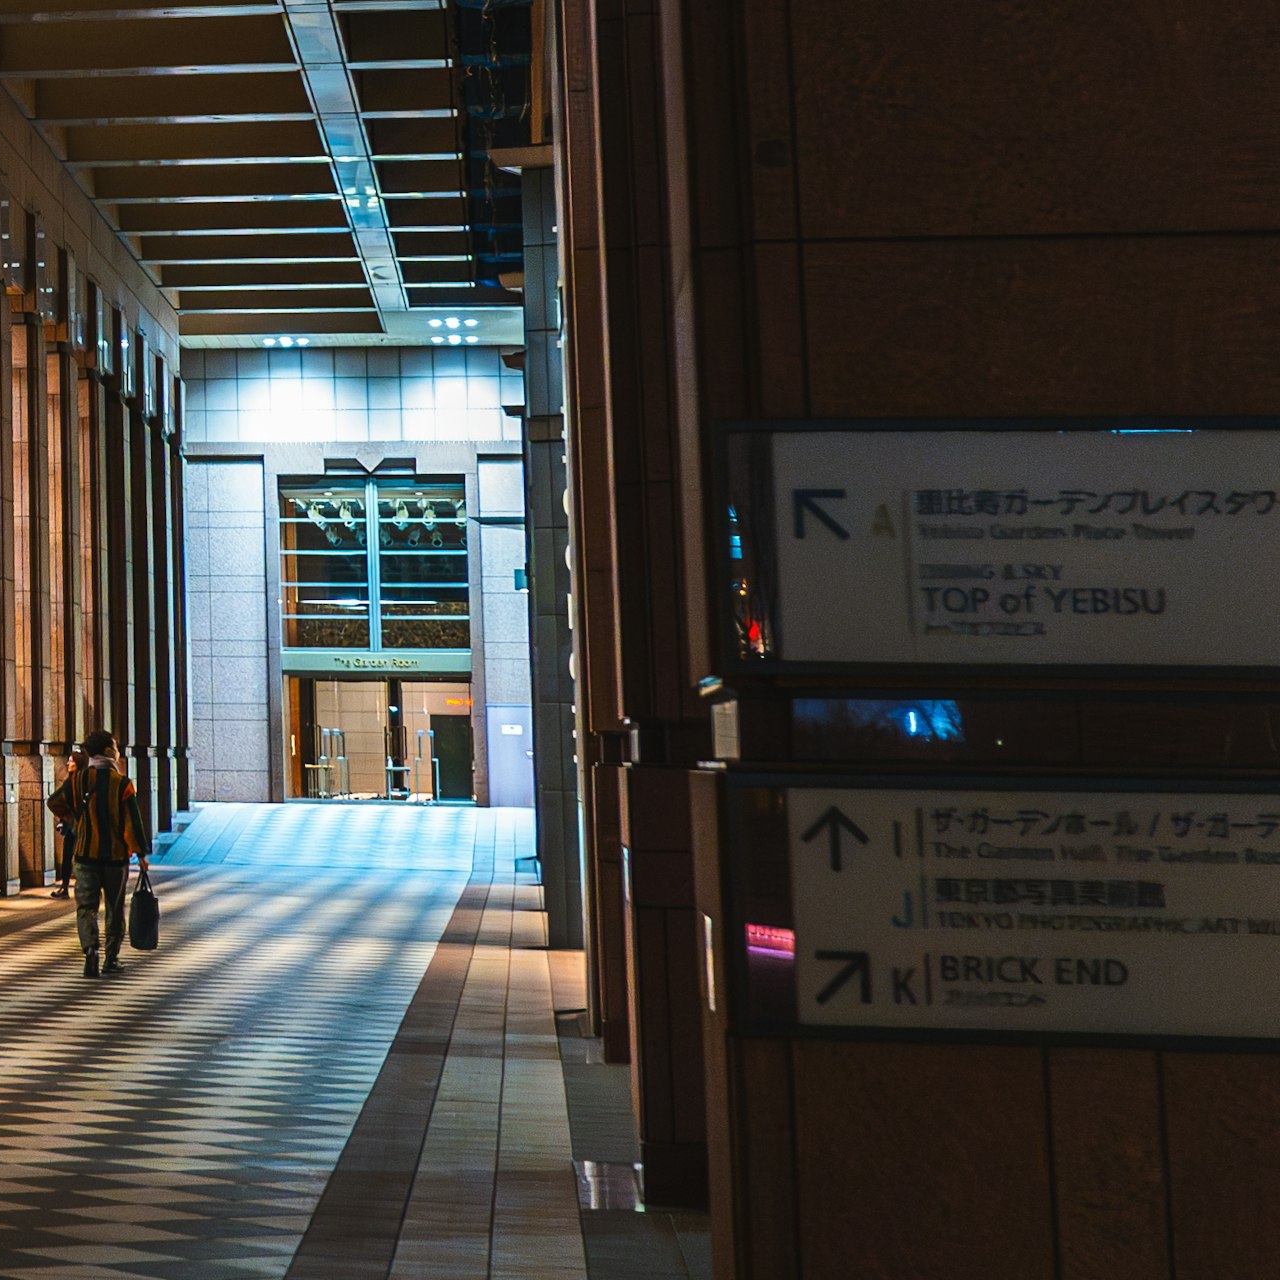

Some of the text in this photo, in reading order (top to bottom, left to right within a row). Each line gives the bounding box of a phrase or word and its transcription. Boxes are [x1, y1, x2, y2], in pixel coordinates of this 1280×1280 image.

[871, 502, 896, 537] A
[921, 586, 1167, 615] TOP of YEBISU
[892, 888, 914, 928] J
[937, 911, 1013, 931] TOKYO
[891, 968, 918, 1007] K
[940, 955, 1130, 987] BRICK END
